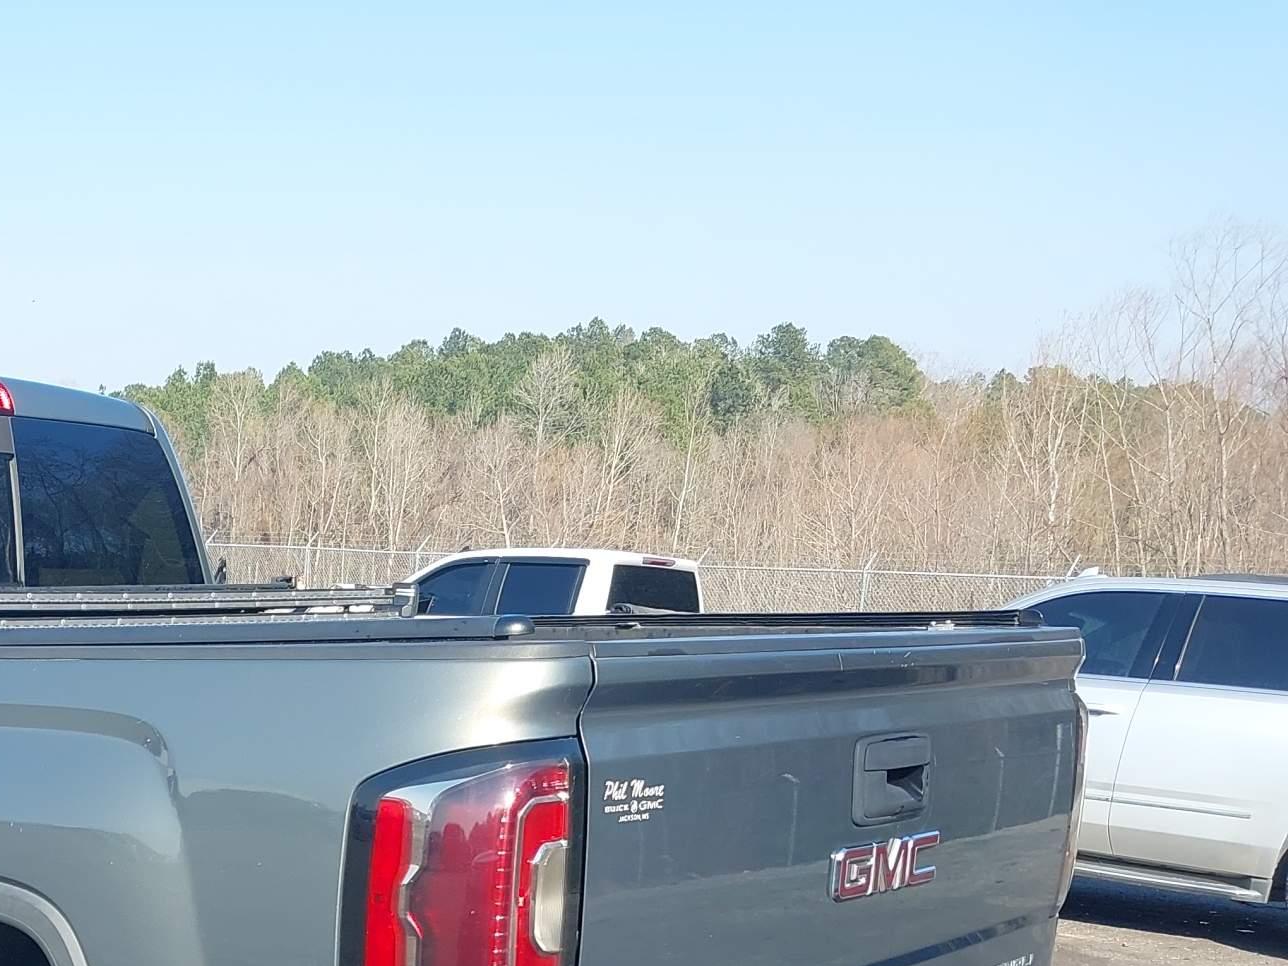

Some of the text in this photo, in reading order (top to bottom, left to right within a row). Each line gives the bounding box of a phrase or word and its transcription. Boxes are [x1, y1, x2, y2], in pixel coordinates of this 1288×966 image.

[603, 778, 665, 801] Phil Moore
[604, 798, 664, 813] BUICK GMC
[830, 829, 940, 903] GMC
